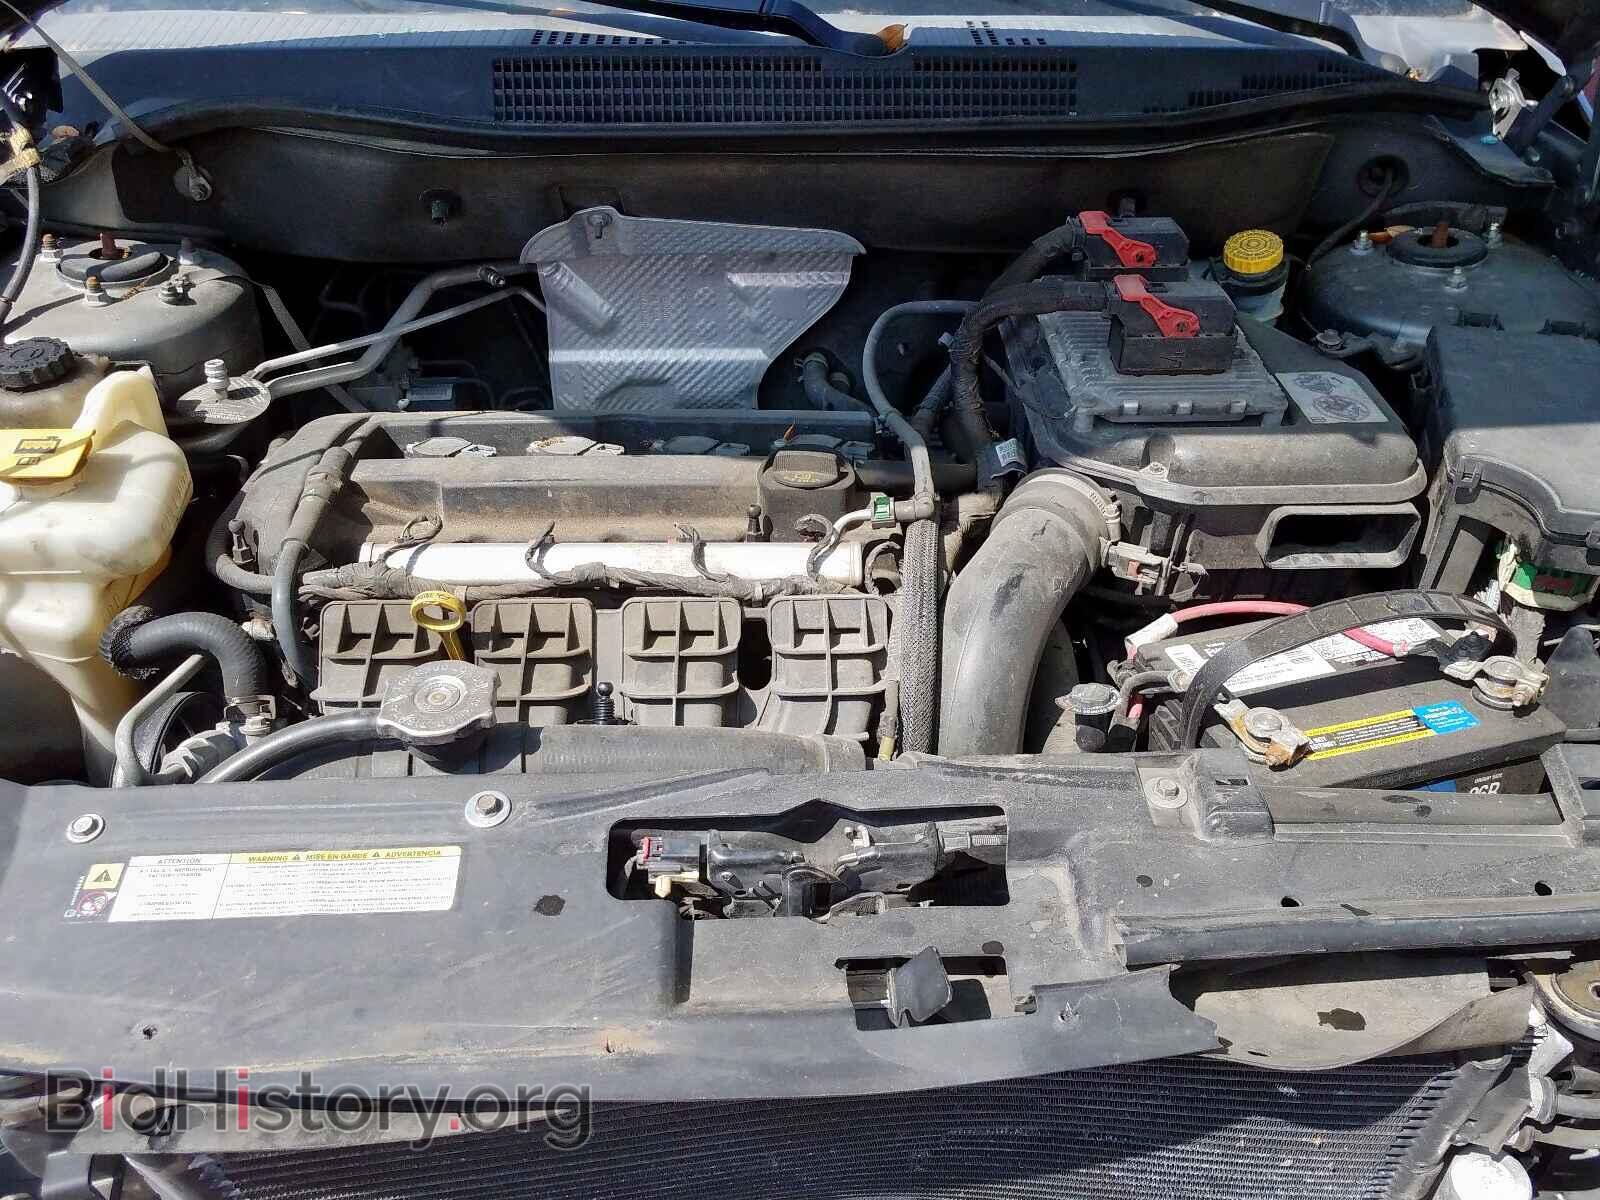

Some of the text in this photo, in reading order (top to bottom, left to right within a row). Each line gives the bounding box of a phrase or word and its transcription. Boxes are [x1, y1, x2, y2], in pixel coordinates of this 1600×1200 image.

[158, 857, 201, 865] ATTENTION
[247, 855, 289, 863] WARNING
[384, 850, 441, 858] ADVERTENCIA
